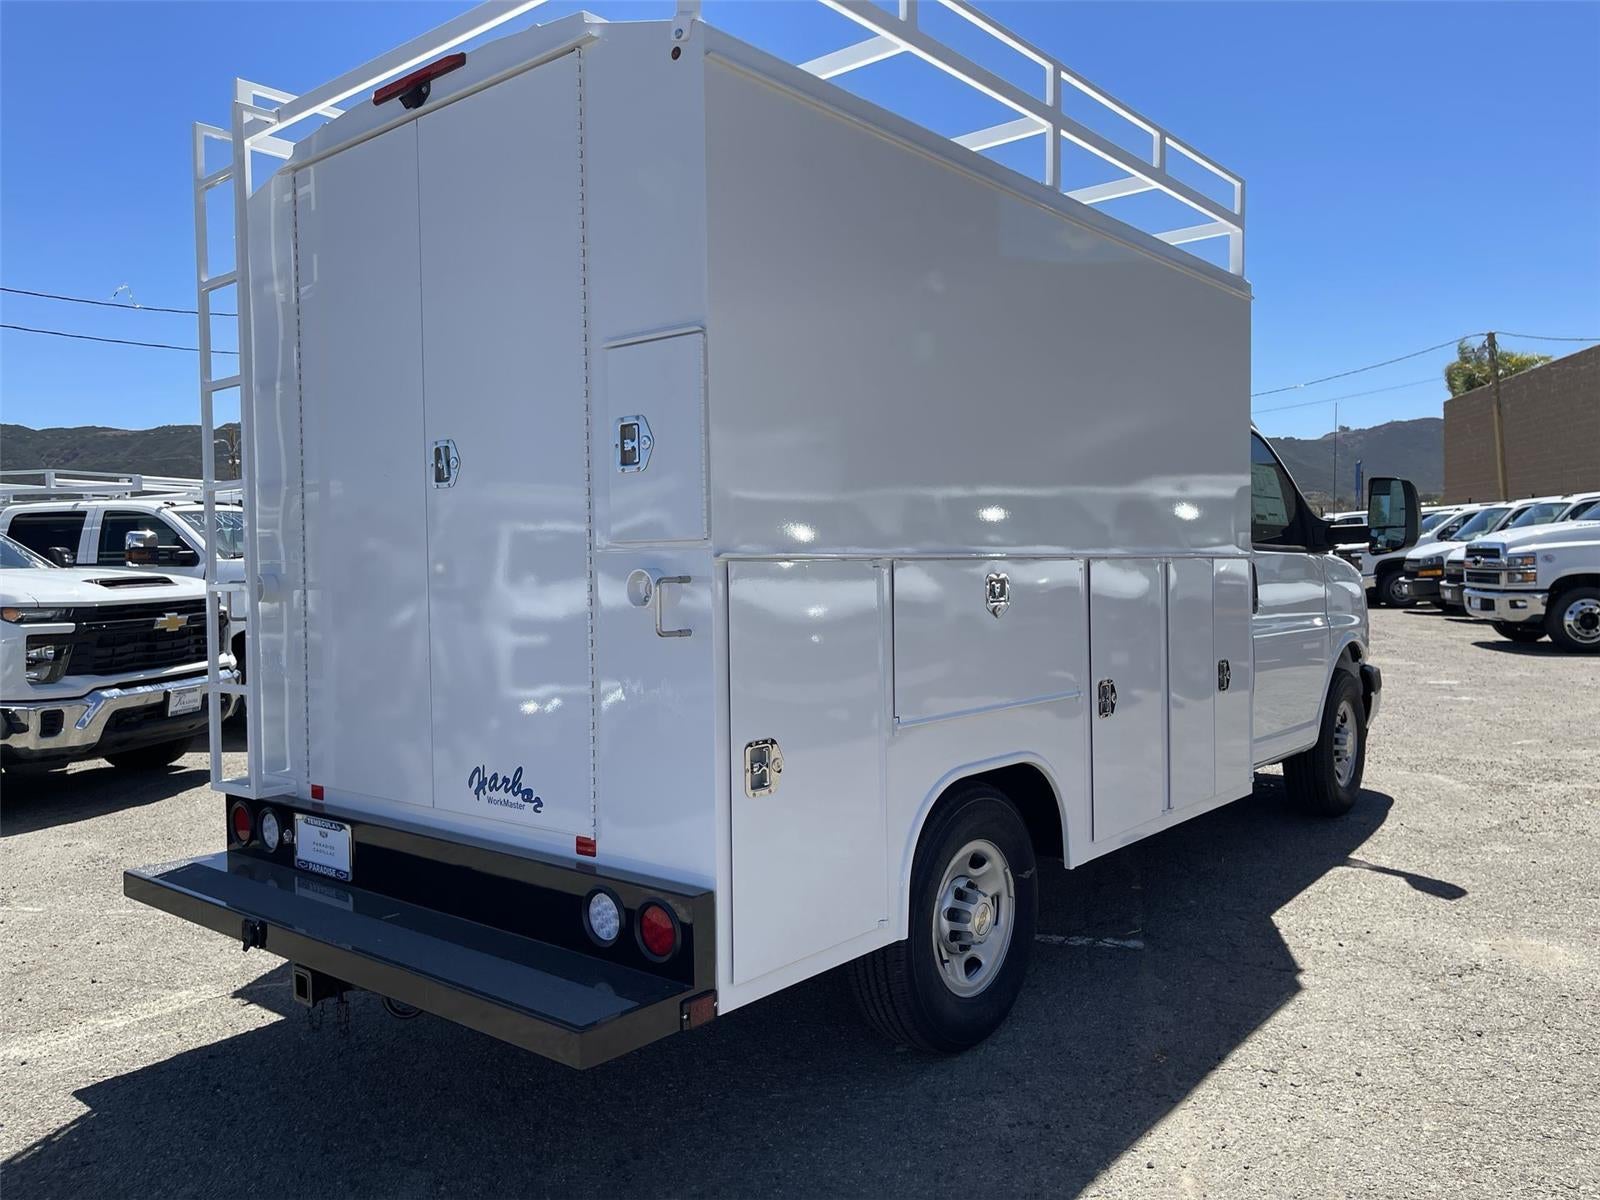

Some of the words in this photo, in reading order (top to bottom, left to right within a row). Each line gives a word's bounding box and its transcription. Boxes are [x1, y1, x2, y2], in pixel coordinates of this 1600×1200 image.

[486, 795, 526, 811] WorkMaster
[307, 817, 337, 830] TEMECULA
[308, 861, 337, 877] PARADISE
